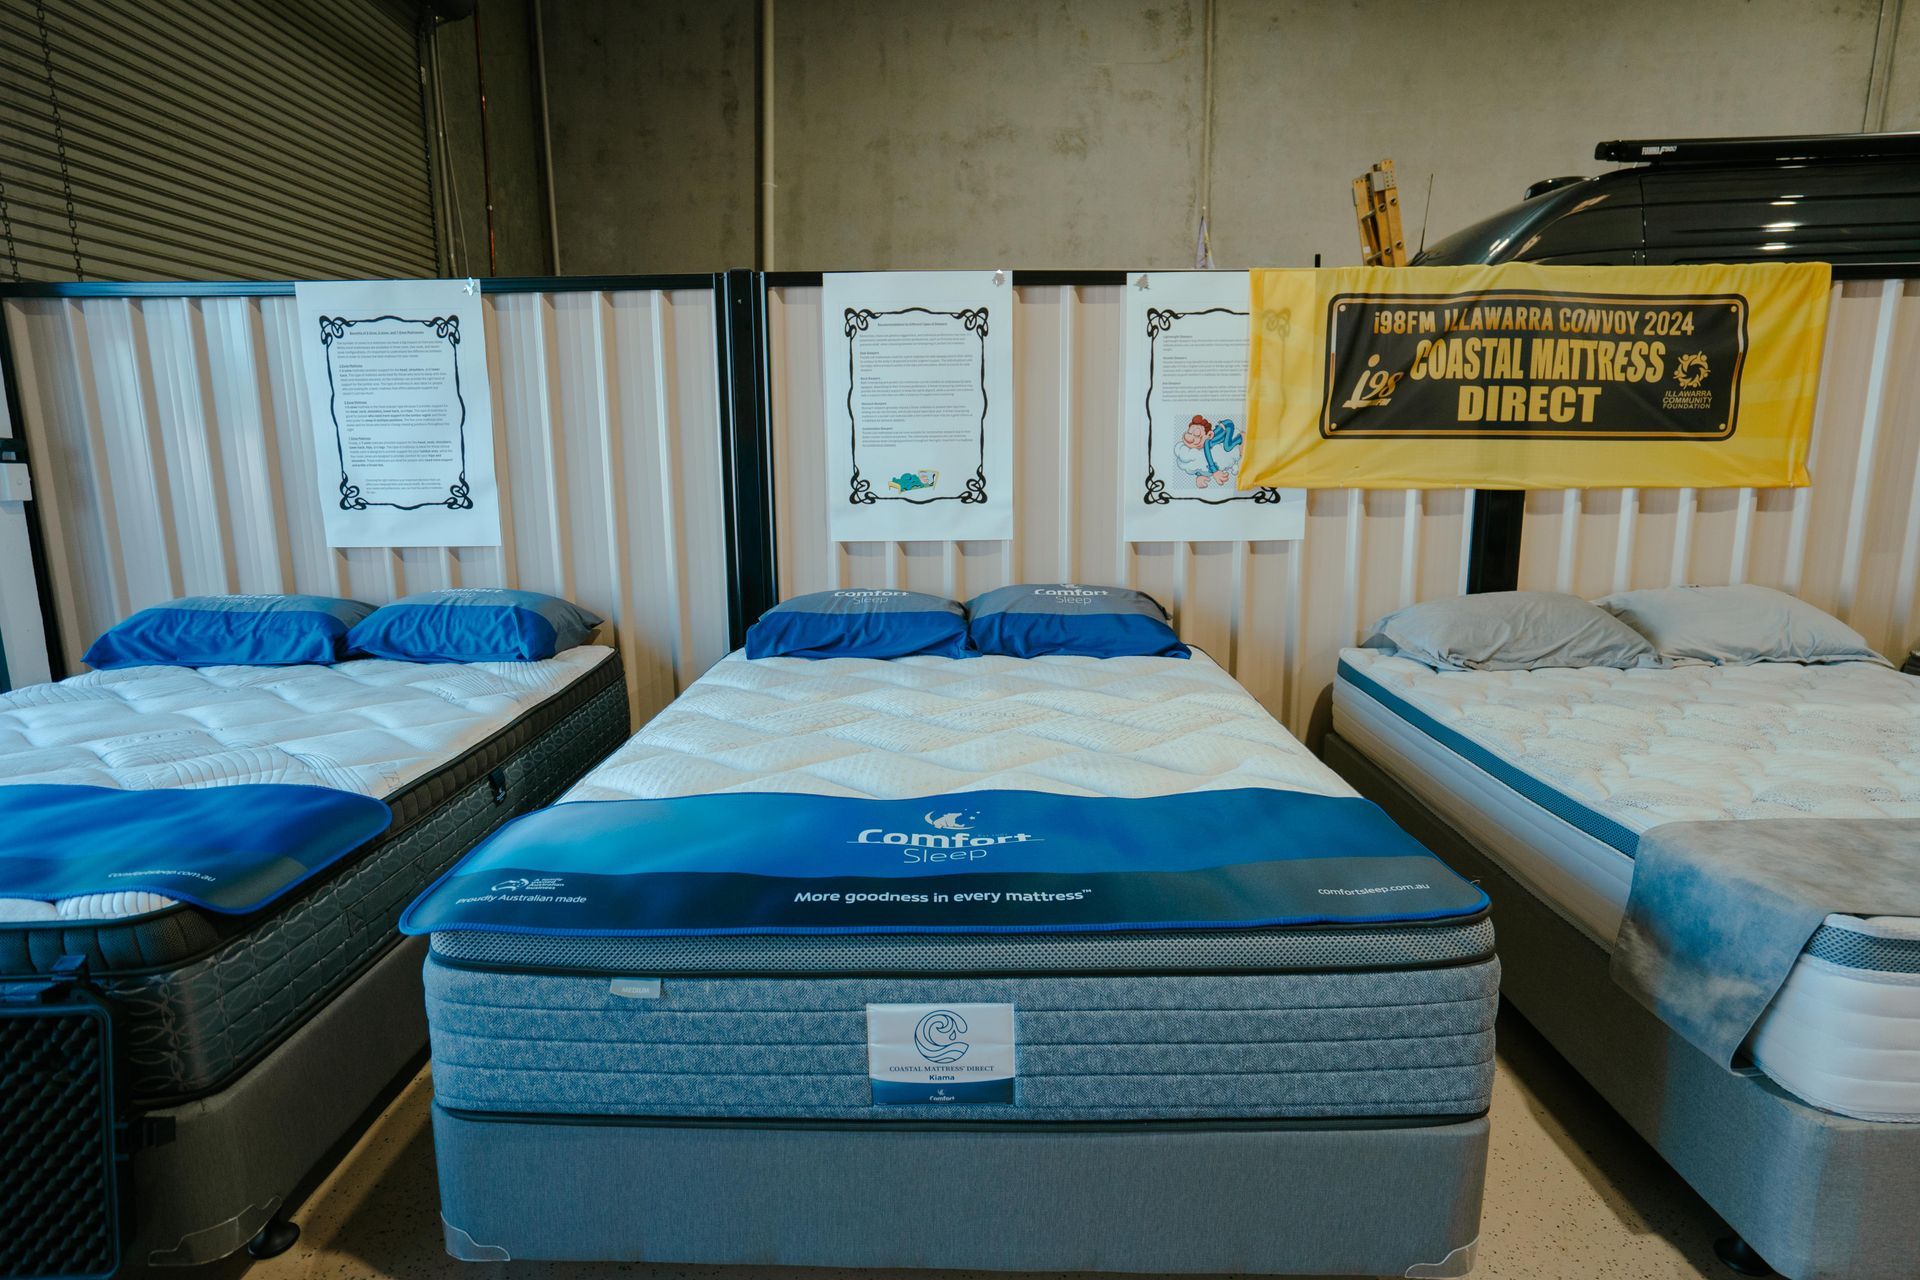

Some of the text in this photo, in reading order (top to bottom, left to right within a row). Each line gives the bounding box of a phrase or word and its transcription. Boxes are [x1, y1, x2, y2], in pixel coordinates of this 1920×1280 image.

[1373, 306, 1695, 336] i98FM ILLAWARRA CONVOY 2024
[1410, 337, 1666, 383] COASTAL MATTRESS
[1665, 390, 1712, 398] ILLAWARRA
[1457, 386, 1602, 423] DIRECT
[1034, 588, 1109, 597] Comfort
[1055, 596, 1092, 605] Sleep
[857, 828, 1032, 849] Comfort
[903, 848, 988, 864] Sleep
[1318, 884, 1431, 896] comfortsleep.com.au
[499, 894, 553, 903] Australian
[555, 895, 588, 904] made
[794, 892, 841, 902] More
[845, 892, 929, 904] goodness
[933, 892, 949, 902] in
[953, 892, 1001, 904] every
